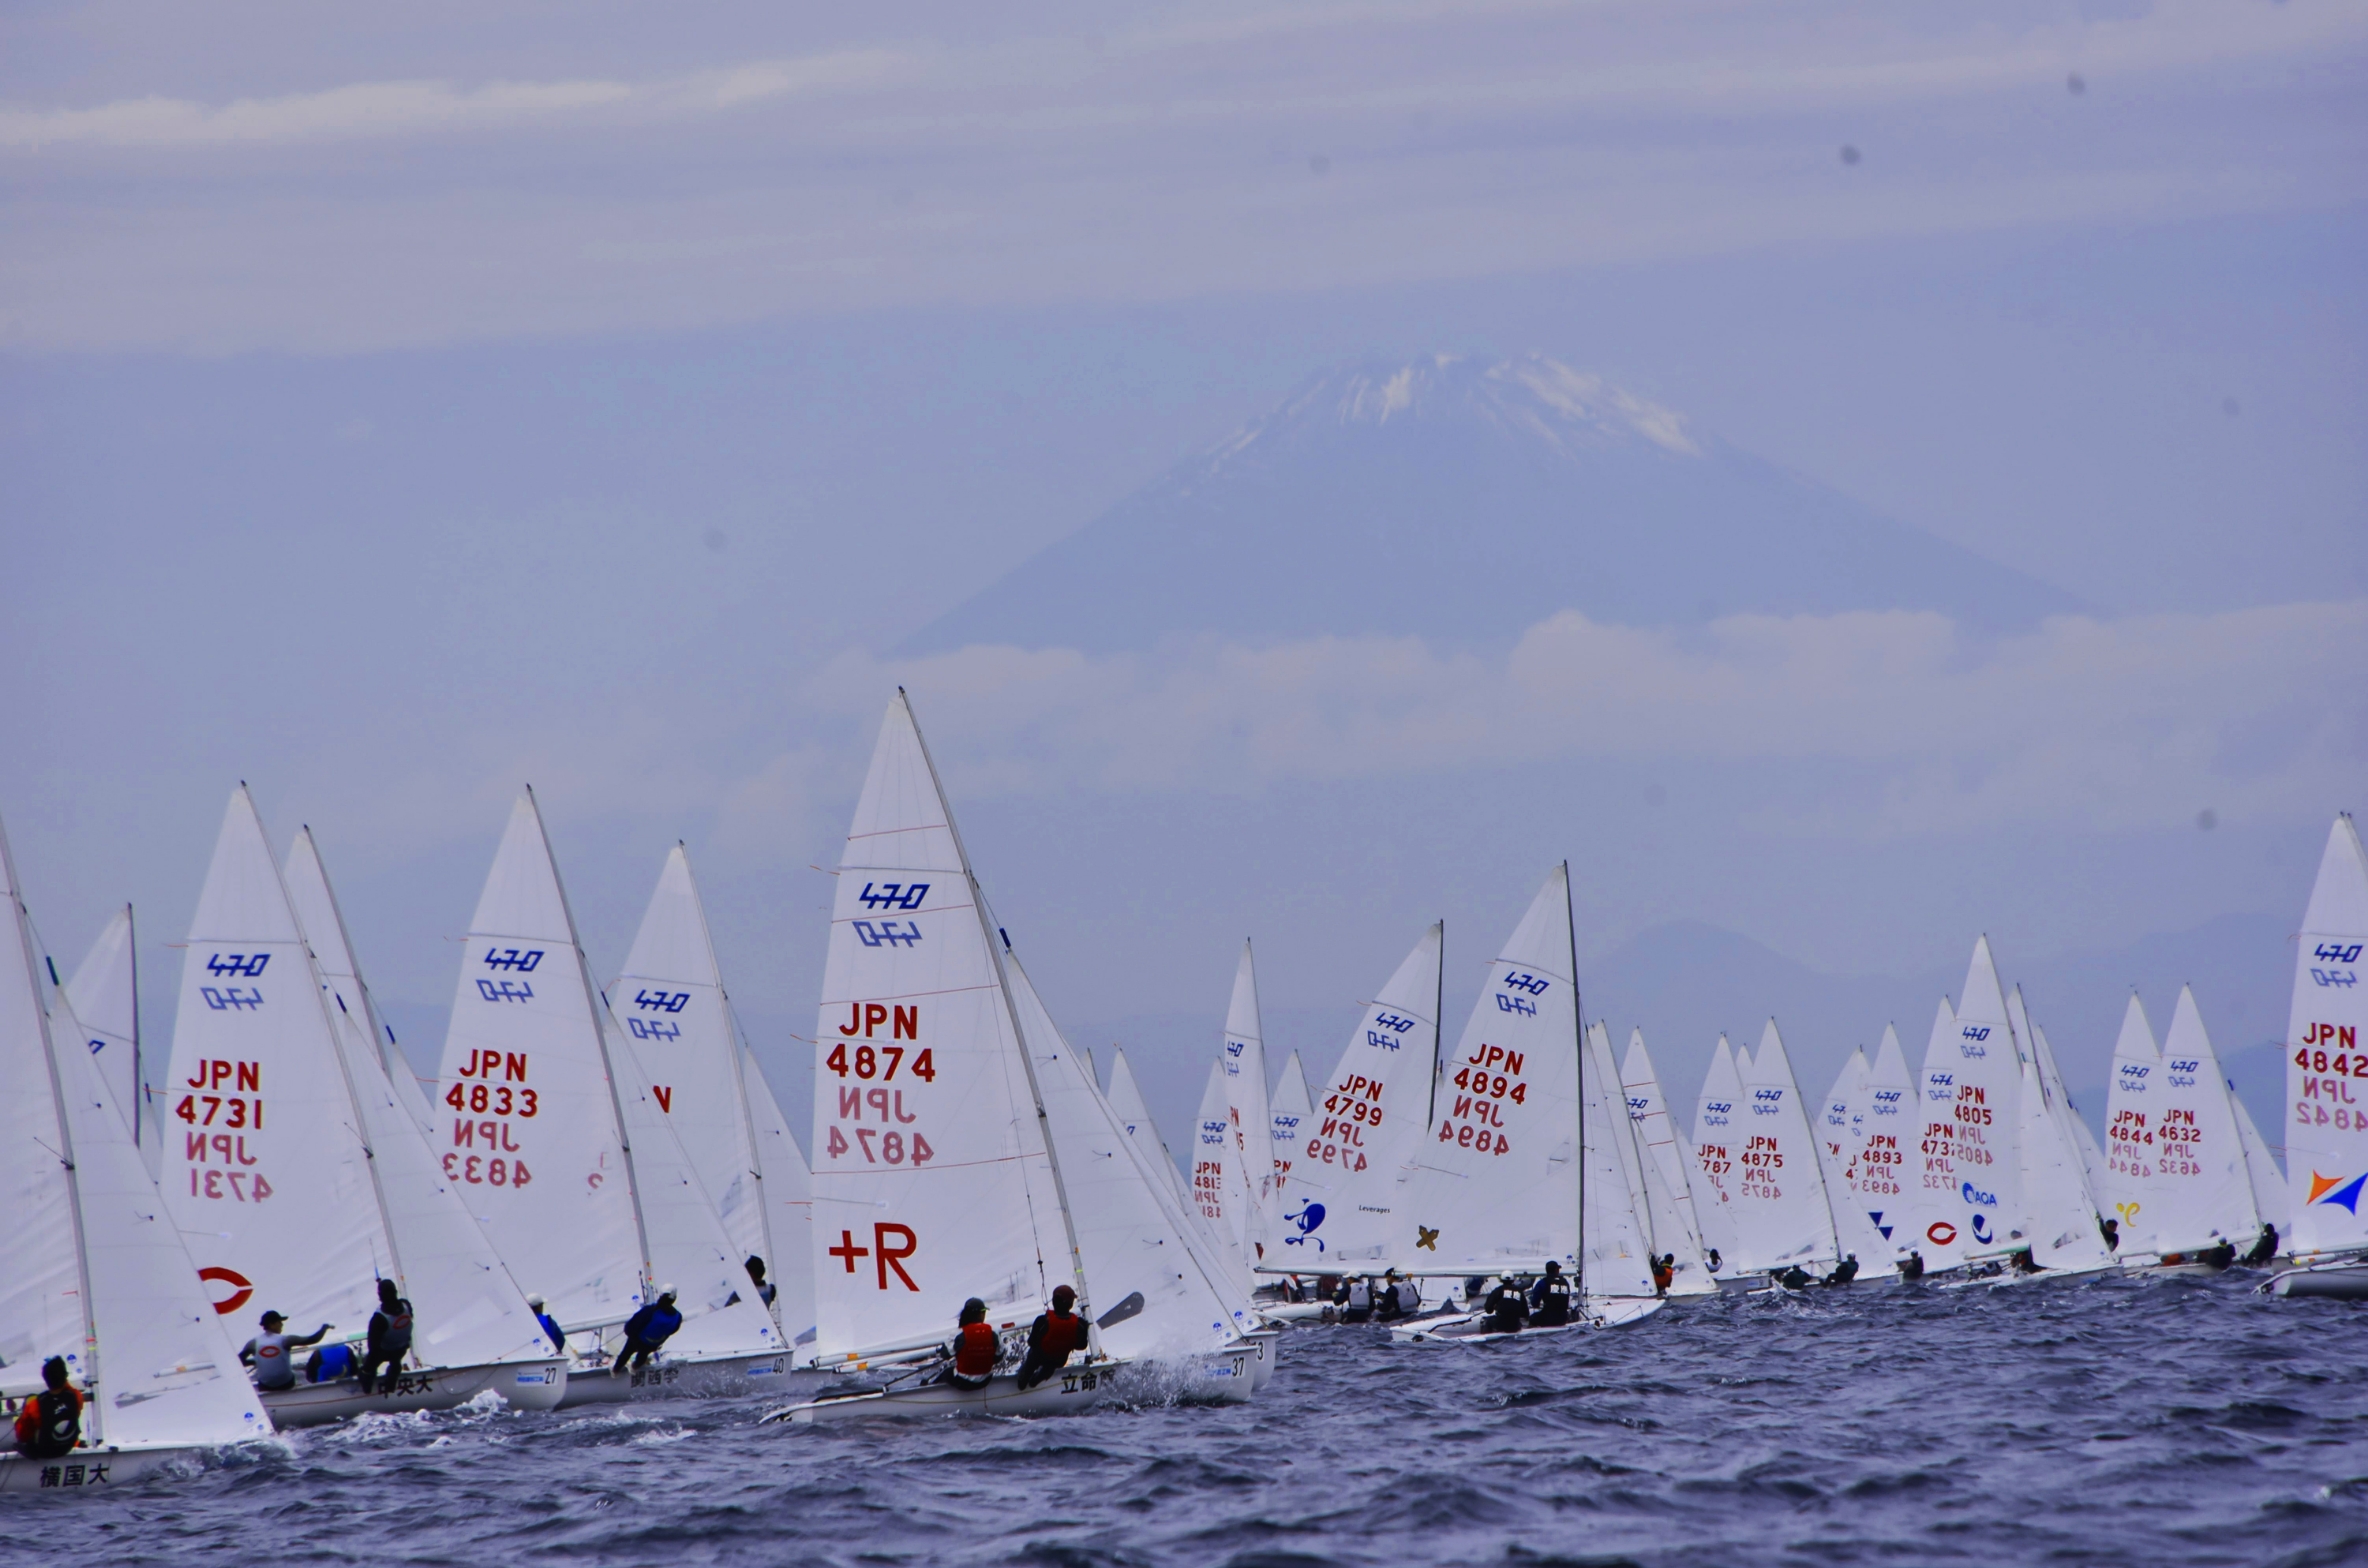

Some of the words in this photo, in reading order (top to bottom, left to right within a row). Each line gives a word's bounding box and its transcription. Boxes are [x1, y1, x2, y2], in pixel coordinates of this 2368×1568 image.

[859, 883, 929, 909] 470
[485, 948, 544, 972] 470
[2315, 944, 2363, 962] 470
[207, 954, 270, 976] 470
[1504, 972, 1549, 997] 470
[635, 990, 690, 1012] 470
[839, 1003, 917, 1040] JPN
[1375, 1013, 1414, 1034] 470
[1963, 1028, 1990, 1041] 470
[2300, 1023, 2356, 1050] JPN
[456, 1049, 526, 1083] JPN
[827, 1044, 935, 1082] 4874
[1468, 1044, 1523, 1075] JPN
[2171, 1061, 2198, 1072] 470
[2295, 1047, 2368, 1079] 4842
[188, 1059, 259, 1091] JPN
[2120, 1064, 2150, 1077] 470
[1339, 1074, 1382, 1102] JPN
[1454, 1067, 1526, 1106] 4894
[1756, 1091, 1782, 1100] 470
[1957, 1085, 1984, 1105] JPN
[446, 1083, 537, 1118] 4833
[1876, 1092, 1901, 1102] 470
[176, 1095, 261, 1129] 4731
[1322, 1096, 1382, 1127] 4799
[1707, 1103, 1731, 1114] 470
[1954, 1104, 1991, 1126] 4805
[2162, 1110, 2194, 1126] JPN
[1275, 1117, 1299, 1127] 470
[2112, 1111, 2145, 1128] JPN
[1925, 1123, 1953, 1139] JPN
[2110, 1126, 2153, 1146] 4844
[2159, 1125, 2200, 1143] 4632
[1699, 1144, 1726, 1159] JPN
[1745, 1137, 1776, 1152] JPN
[1866, 1135, 1896, 1149] JPN
[1274, 1160, 1291, 1173] PN
[1703, 1159, 1730, 1174] 787
[1741, 1152, 1782, 1168] 4875
[1863, 1149, 1902, 1165] 4893
[1196, 1162, 1220, 1175] JPN
[1359, 1206, 1390, 1214] Leverages
[544, 1366, 557, 1385] 27
[772, 1357, 785, 1375] 40
[1231, 1356, 1246, 1378] 37
[40, 1462, 110, 1488] 横国大
